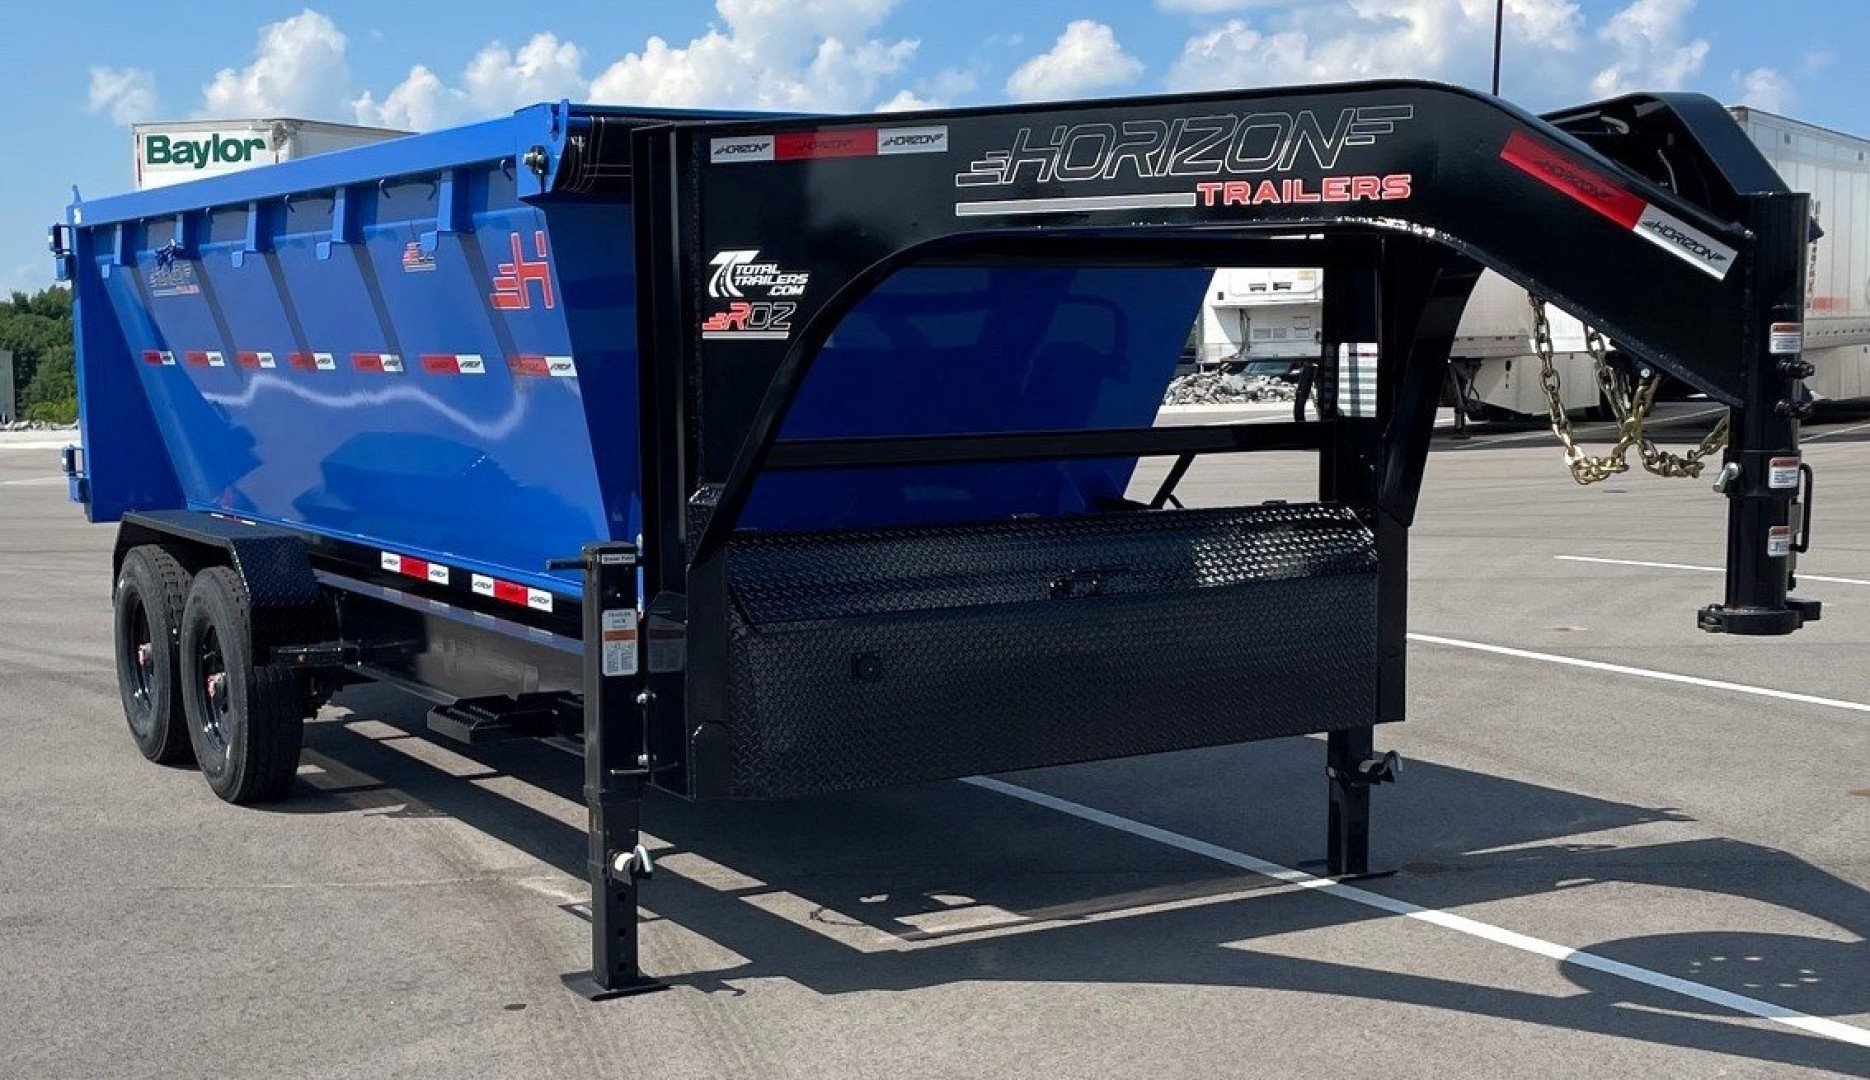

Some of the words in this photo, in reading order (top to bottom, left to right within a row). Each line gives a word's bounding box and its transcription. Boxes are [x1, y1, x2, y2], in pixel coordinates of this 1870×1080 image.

[889, 132, 937, 147] HORIZON
[1001, 107, 1356, 184] HORIZON
[146, 133, 266, 169] Baylor
[720, 143, 766, 155] HORIZON
[1198, 174, 1412, 207] TRAILERS
[1652, 219, 1718, 262] HORIZON
[735, 263, 782, 275] TOTAL
[734, 273, 809, 286] TRAILERS
[766, 284, 805, 296] .COM
